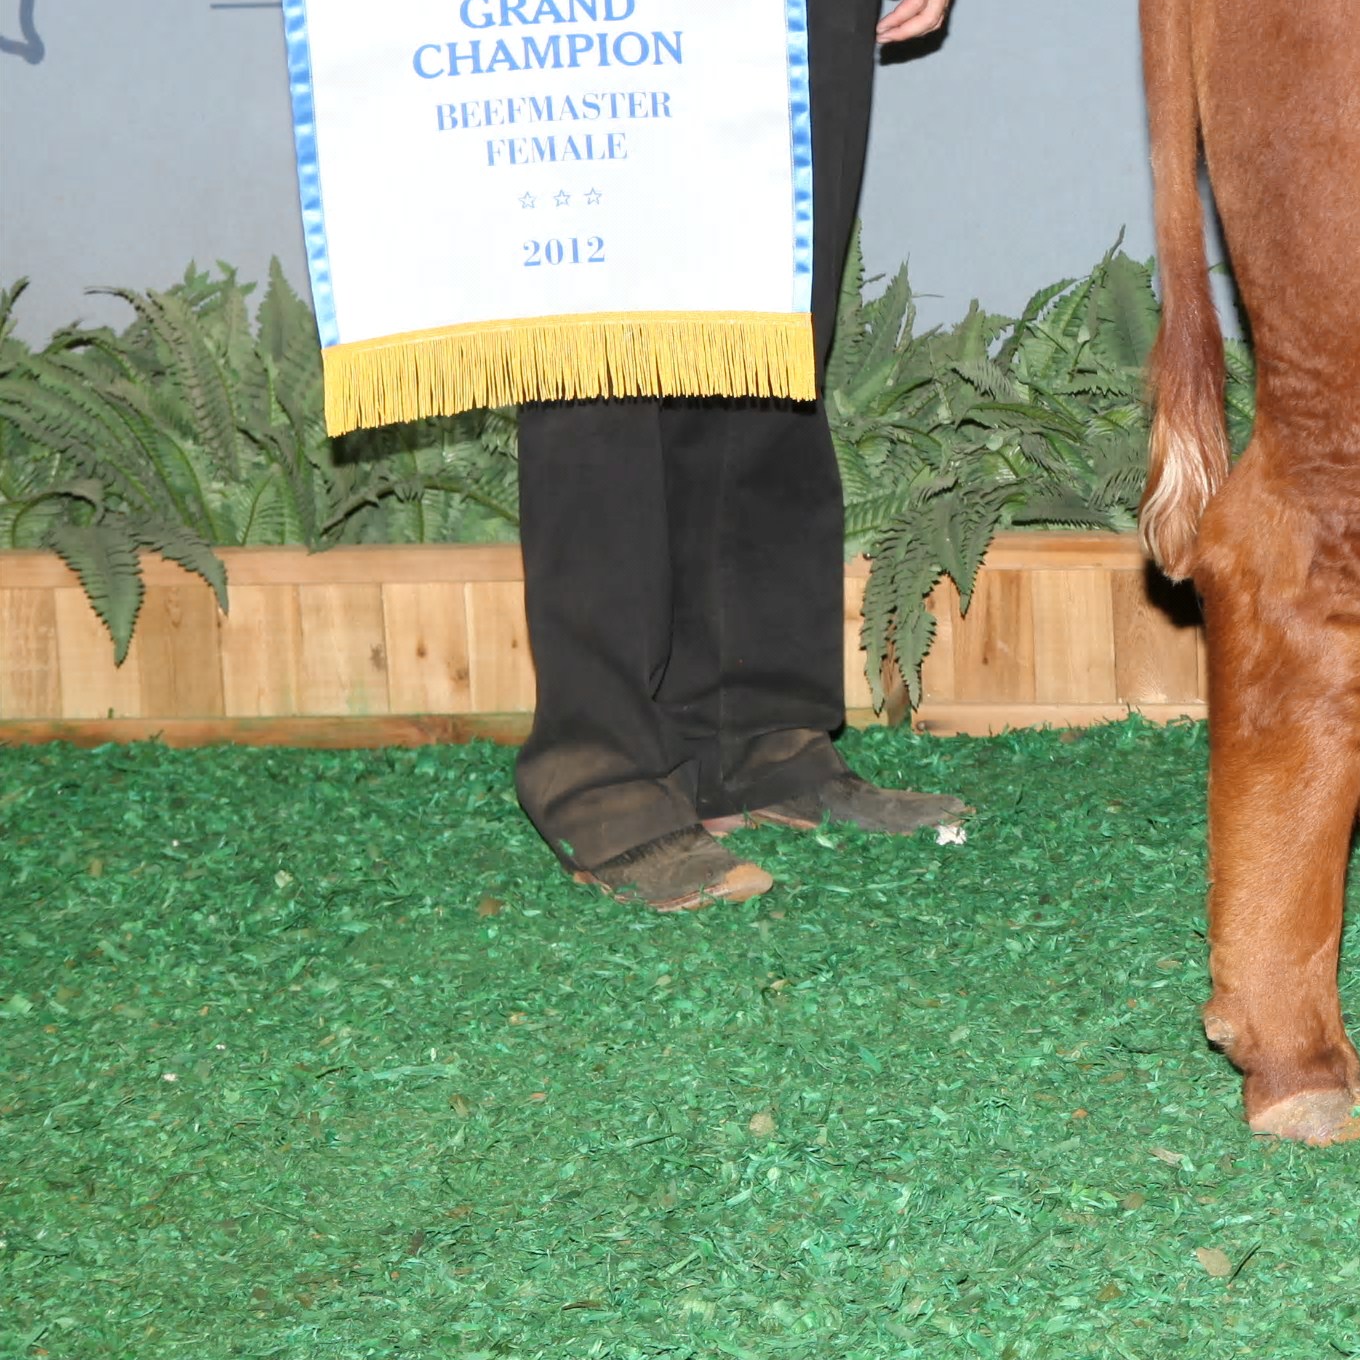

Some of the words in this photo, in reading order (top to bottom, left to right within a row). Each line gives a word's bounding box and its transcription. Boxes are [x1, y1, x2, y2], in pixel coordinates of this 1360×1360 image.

[412, 30, 684, 79] CHAMPION
[435, 90, 673, 131] BEEFMASTER
[486, 132, 628, 167] FEMALE
[522, 235, 606, 267] 2012
